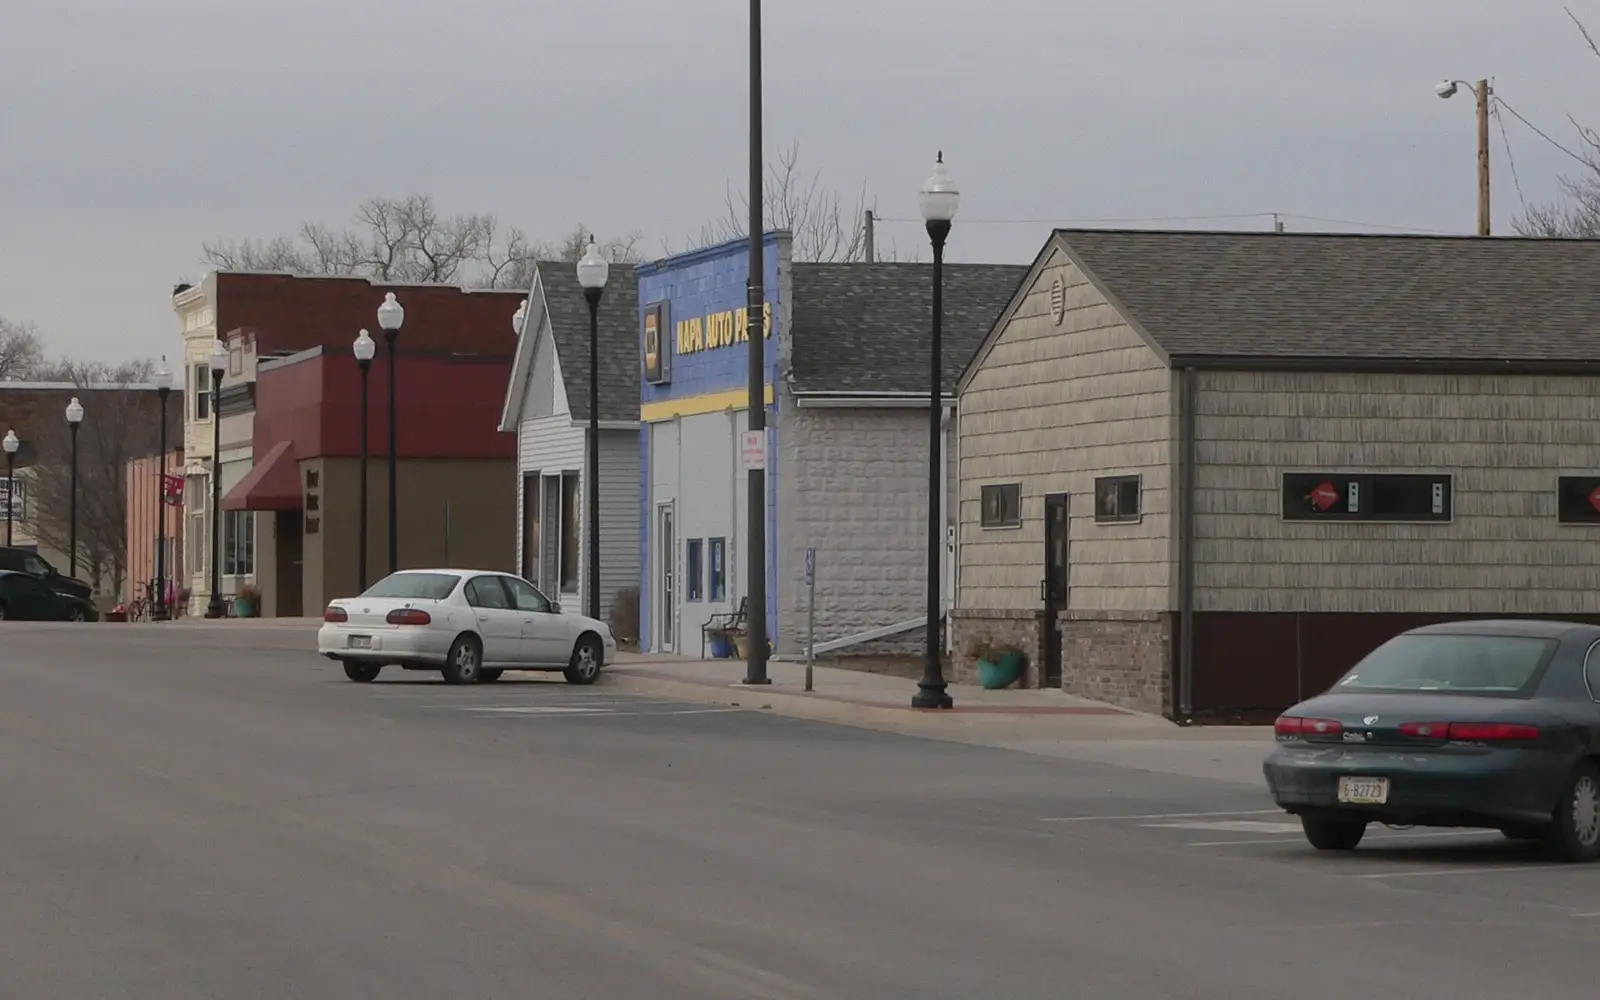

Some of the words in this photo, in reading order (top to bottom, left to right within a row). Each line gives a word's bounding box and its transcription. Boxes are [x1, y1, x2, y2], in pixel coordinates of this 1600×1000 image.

[676, 317, 703, 354] NAPA
[705, 311, 734, 348] AUTO
[735, 302, 772, 343] PAS
